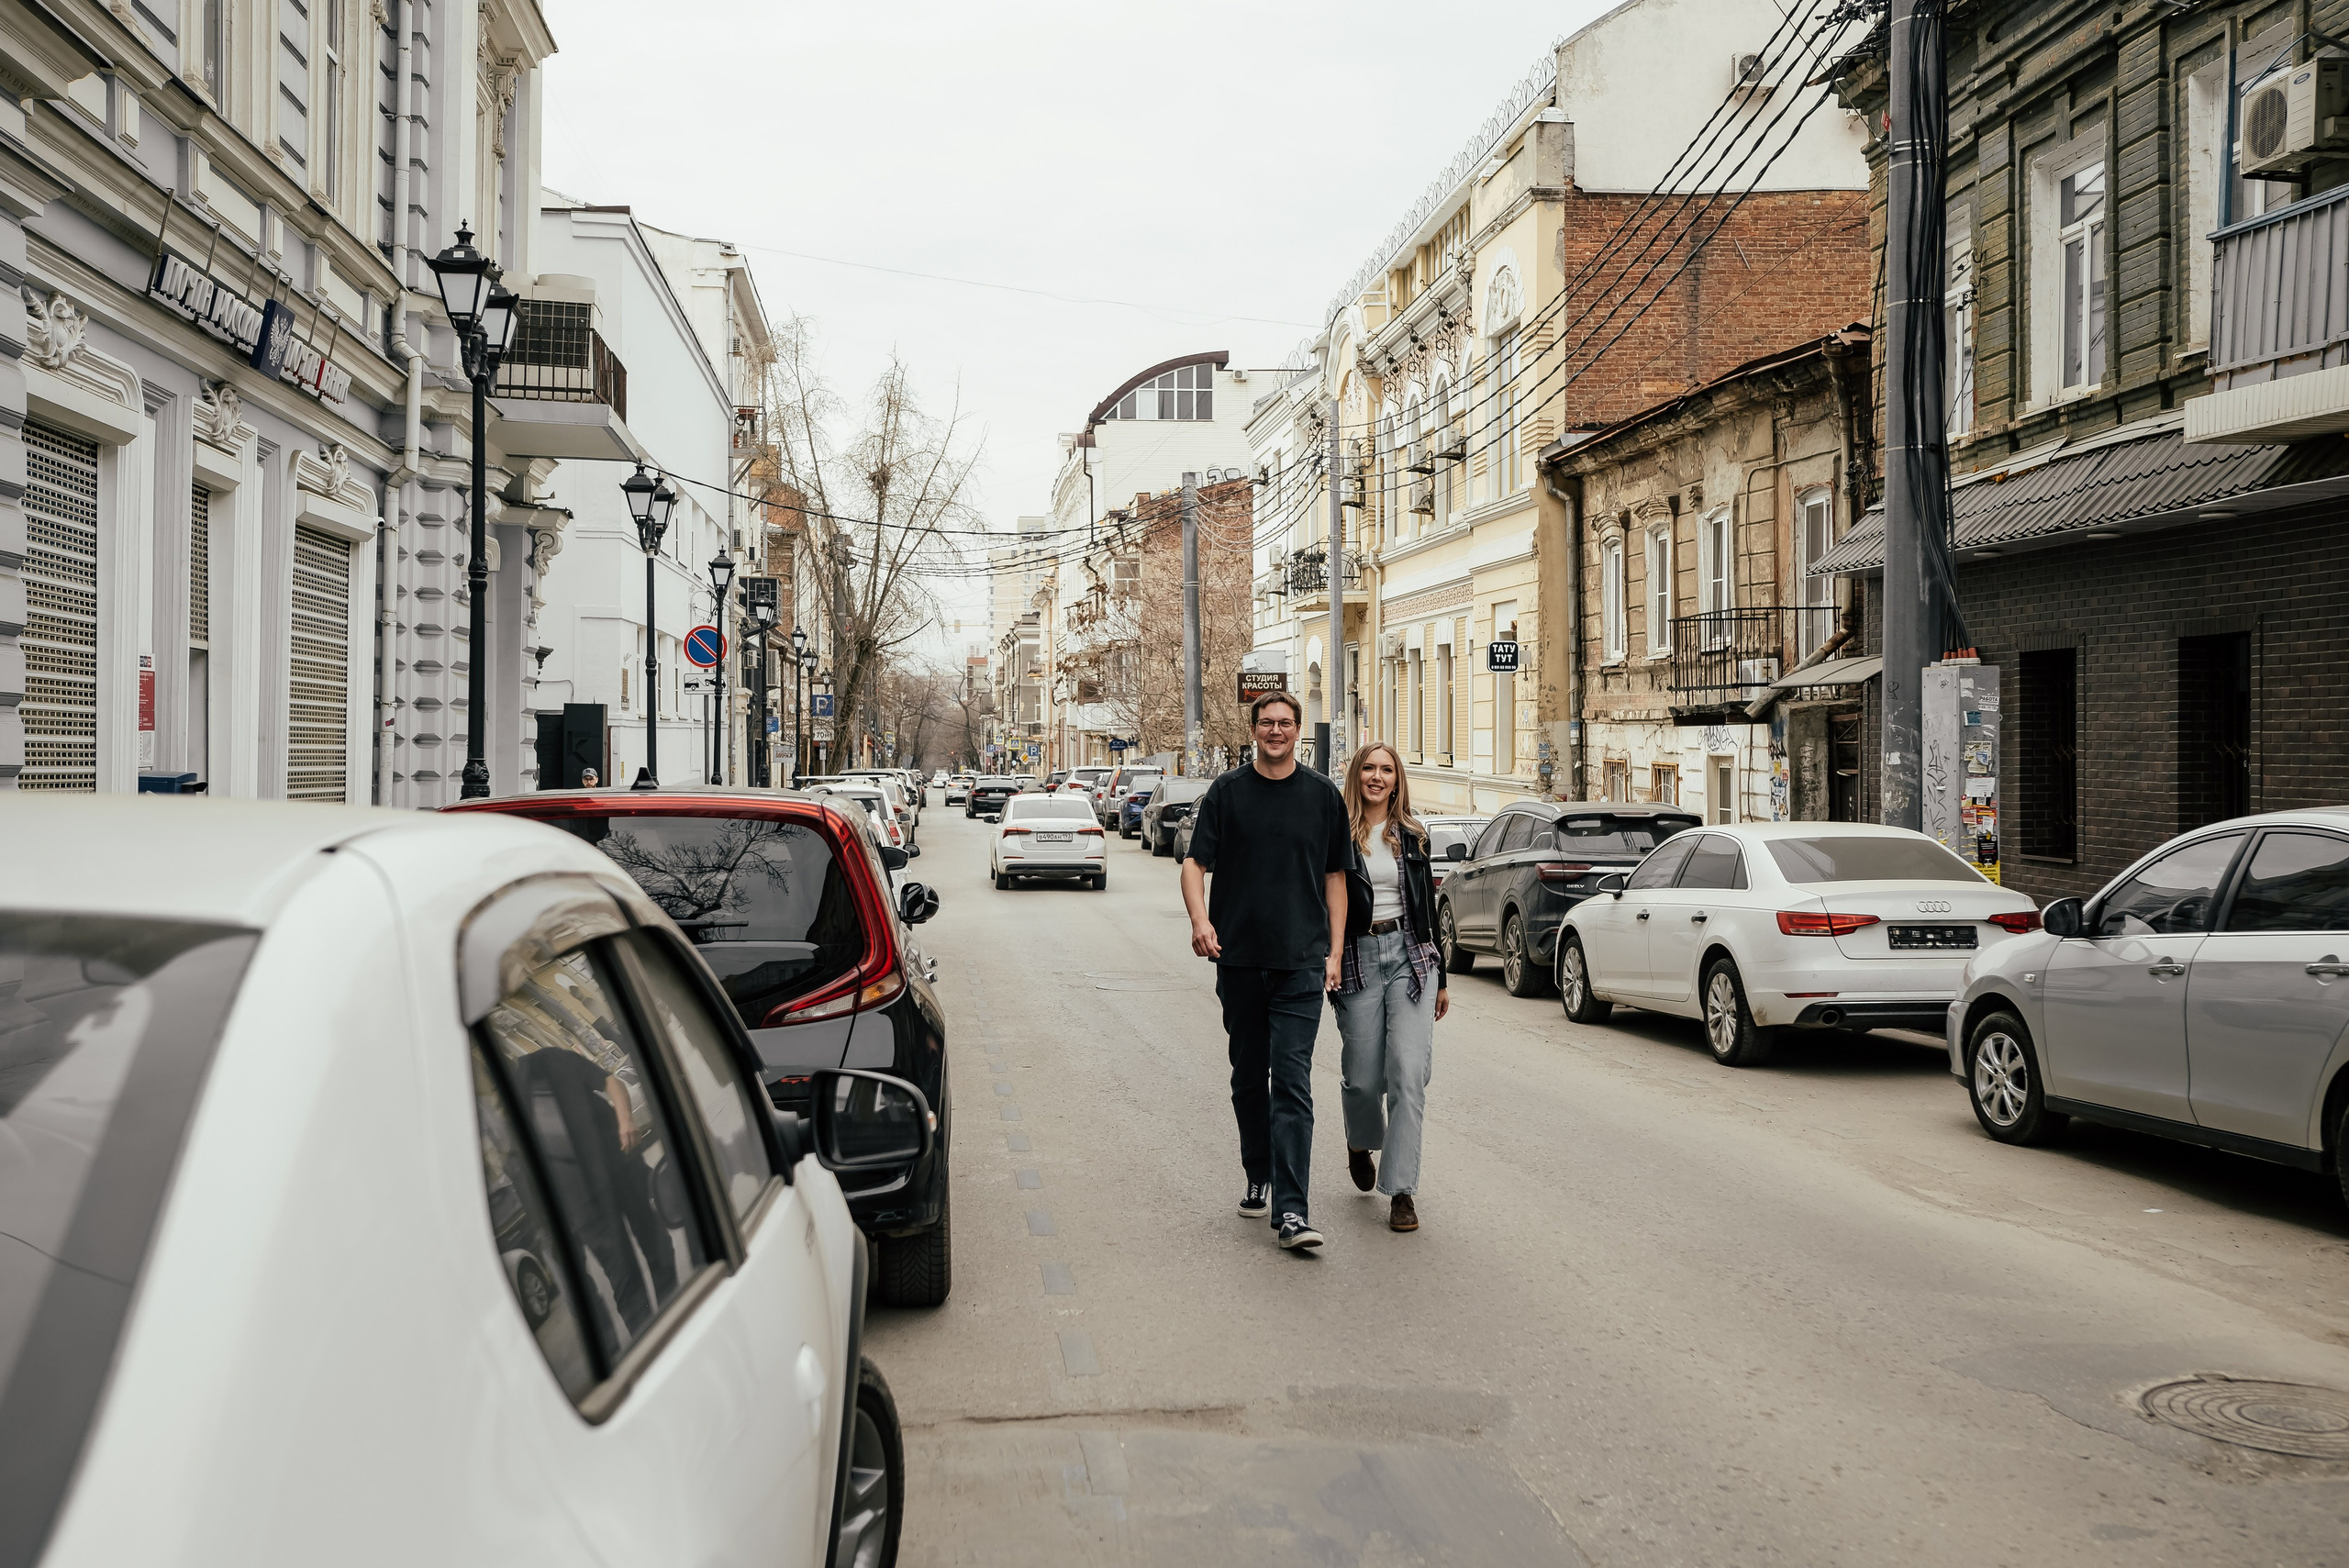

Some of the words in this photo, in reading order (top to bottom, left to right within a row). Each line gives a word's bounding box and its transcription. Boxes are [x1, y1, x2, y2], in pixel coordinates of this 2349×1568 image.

[160, 254, 214, 317] ПОЧТА
[210, 287, 263, 347] РОССИИ
[283, 336, 321, 384] ПОЧТА
[318, 359, 352, 404] БАНК
[1492, 644, 1516, 653] ТАТУ
[1495, 653, 1513, 662] ТУТ
[1245, 674, 1279, 683] СТУДИЯ
